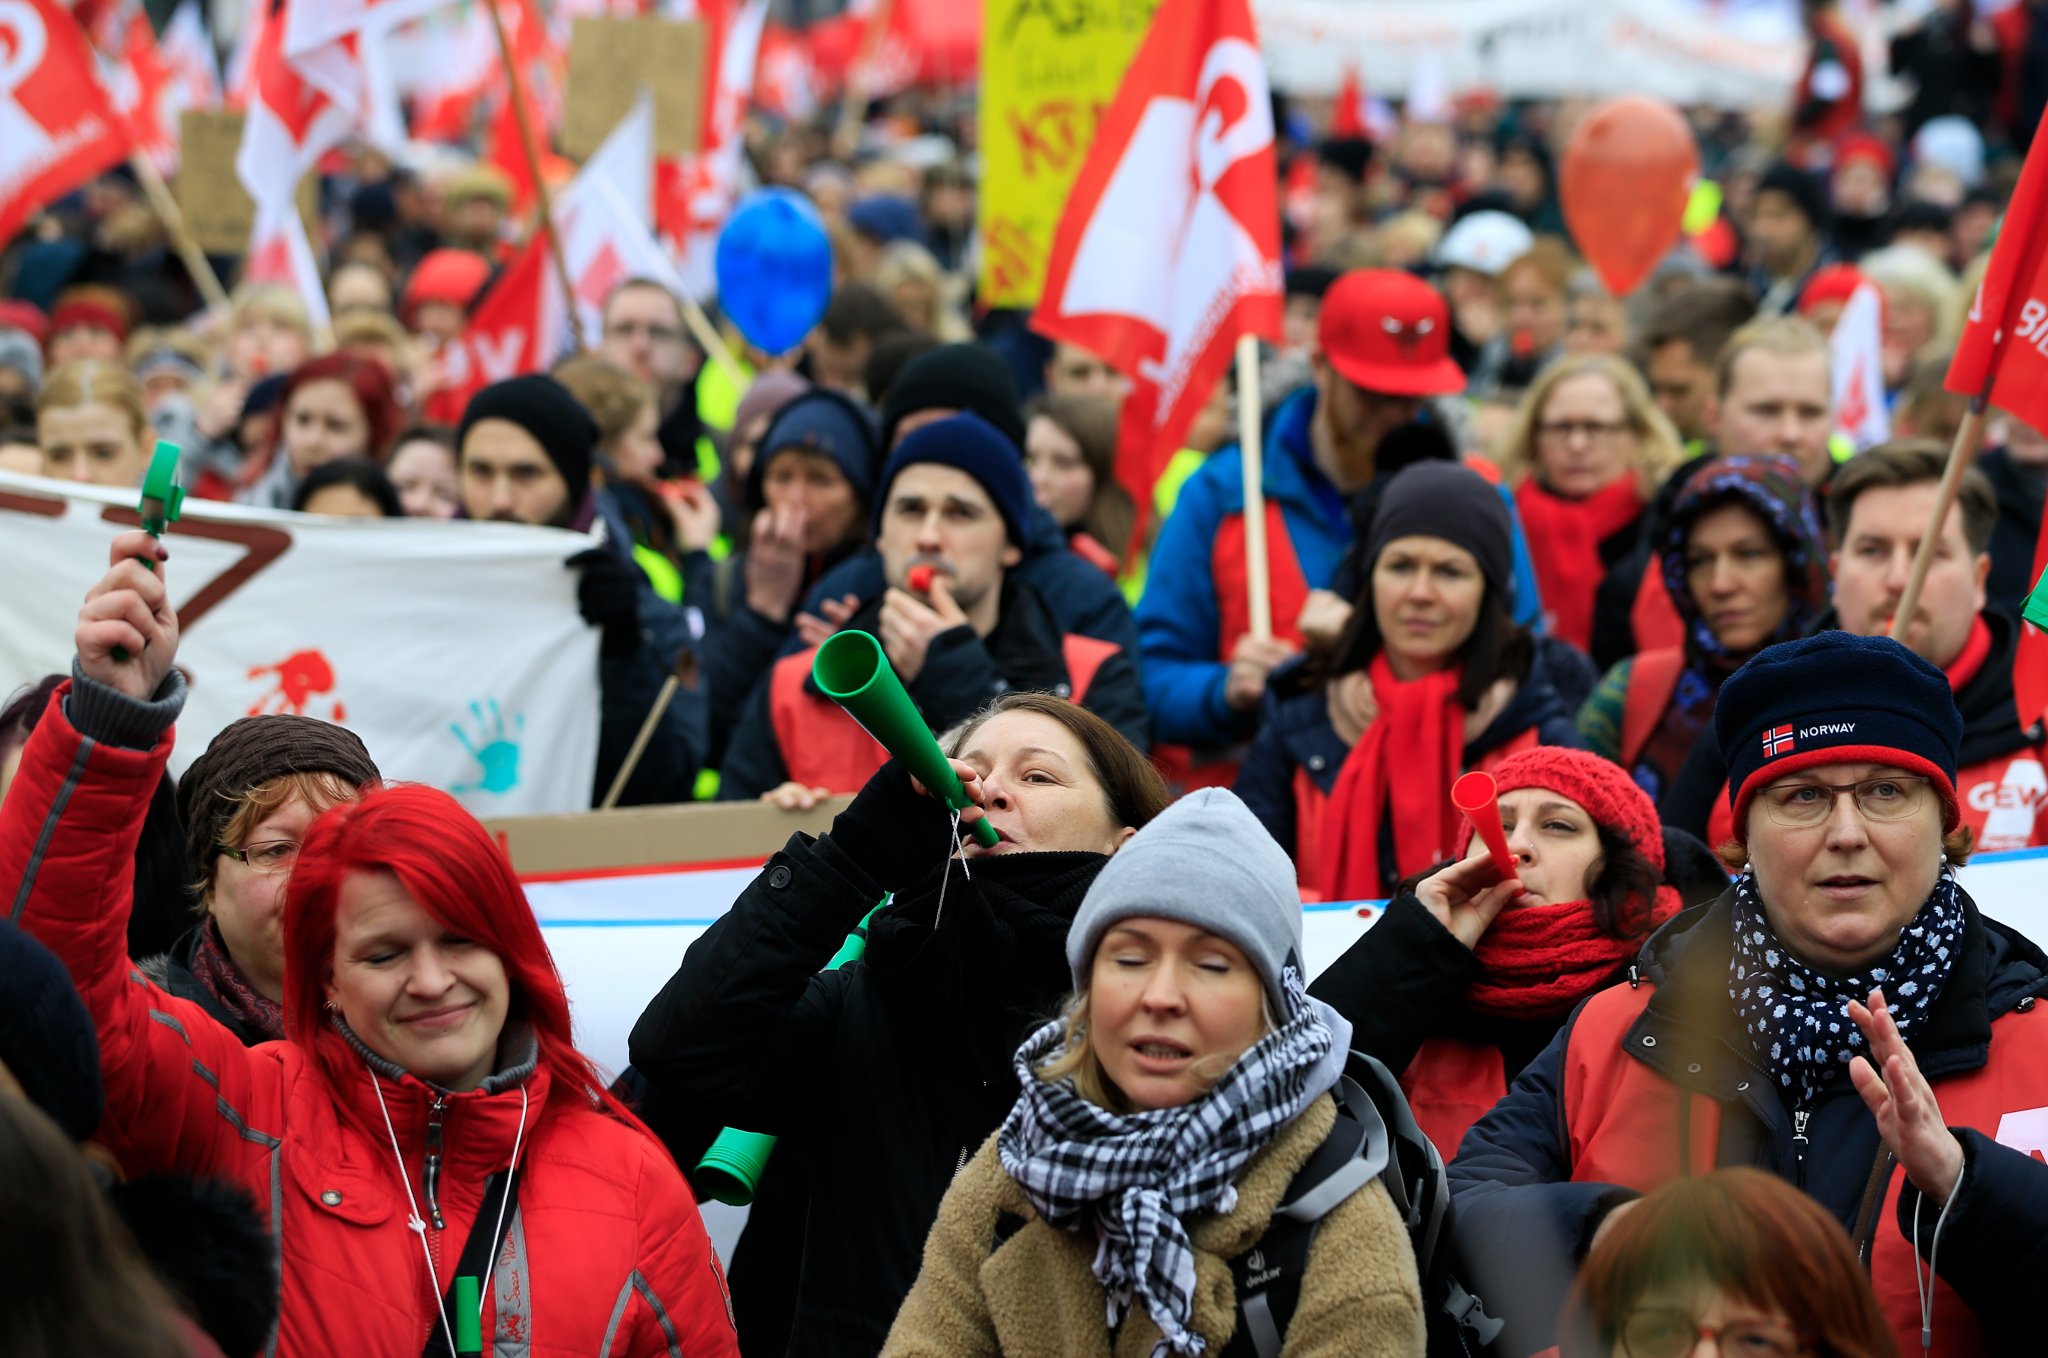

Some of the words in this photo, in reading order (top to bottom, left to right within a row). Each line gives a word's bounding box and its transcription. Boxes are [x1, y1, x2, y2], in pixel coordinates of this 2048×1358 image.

[1800, 723, 1856, 739] NORWAY
[1967, 781, 2048, 814] GEW
[1246, 1266, 1282, 1289] deuter
